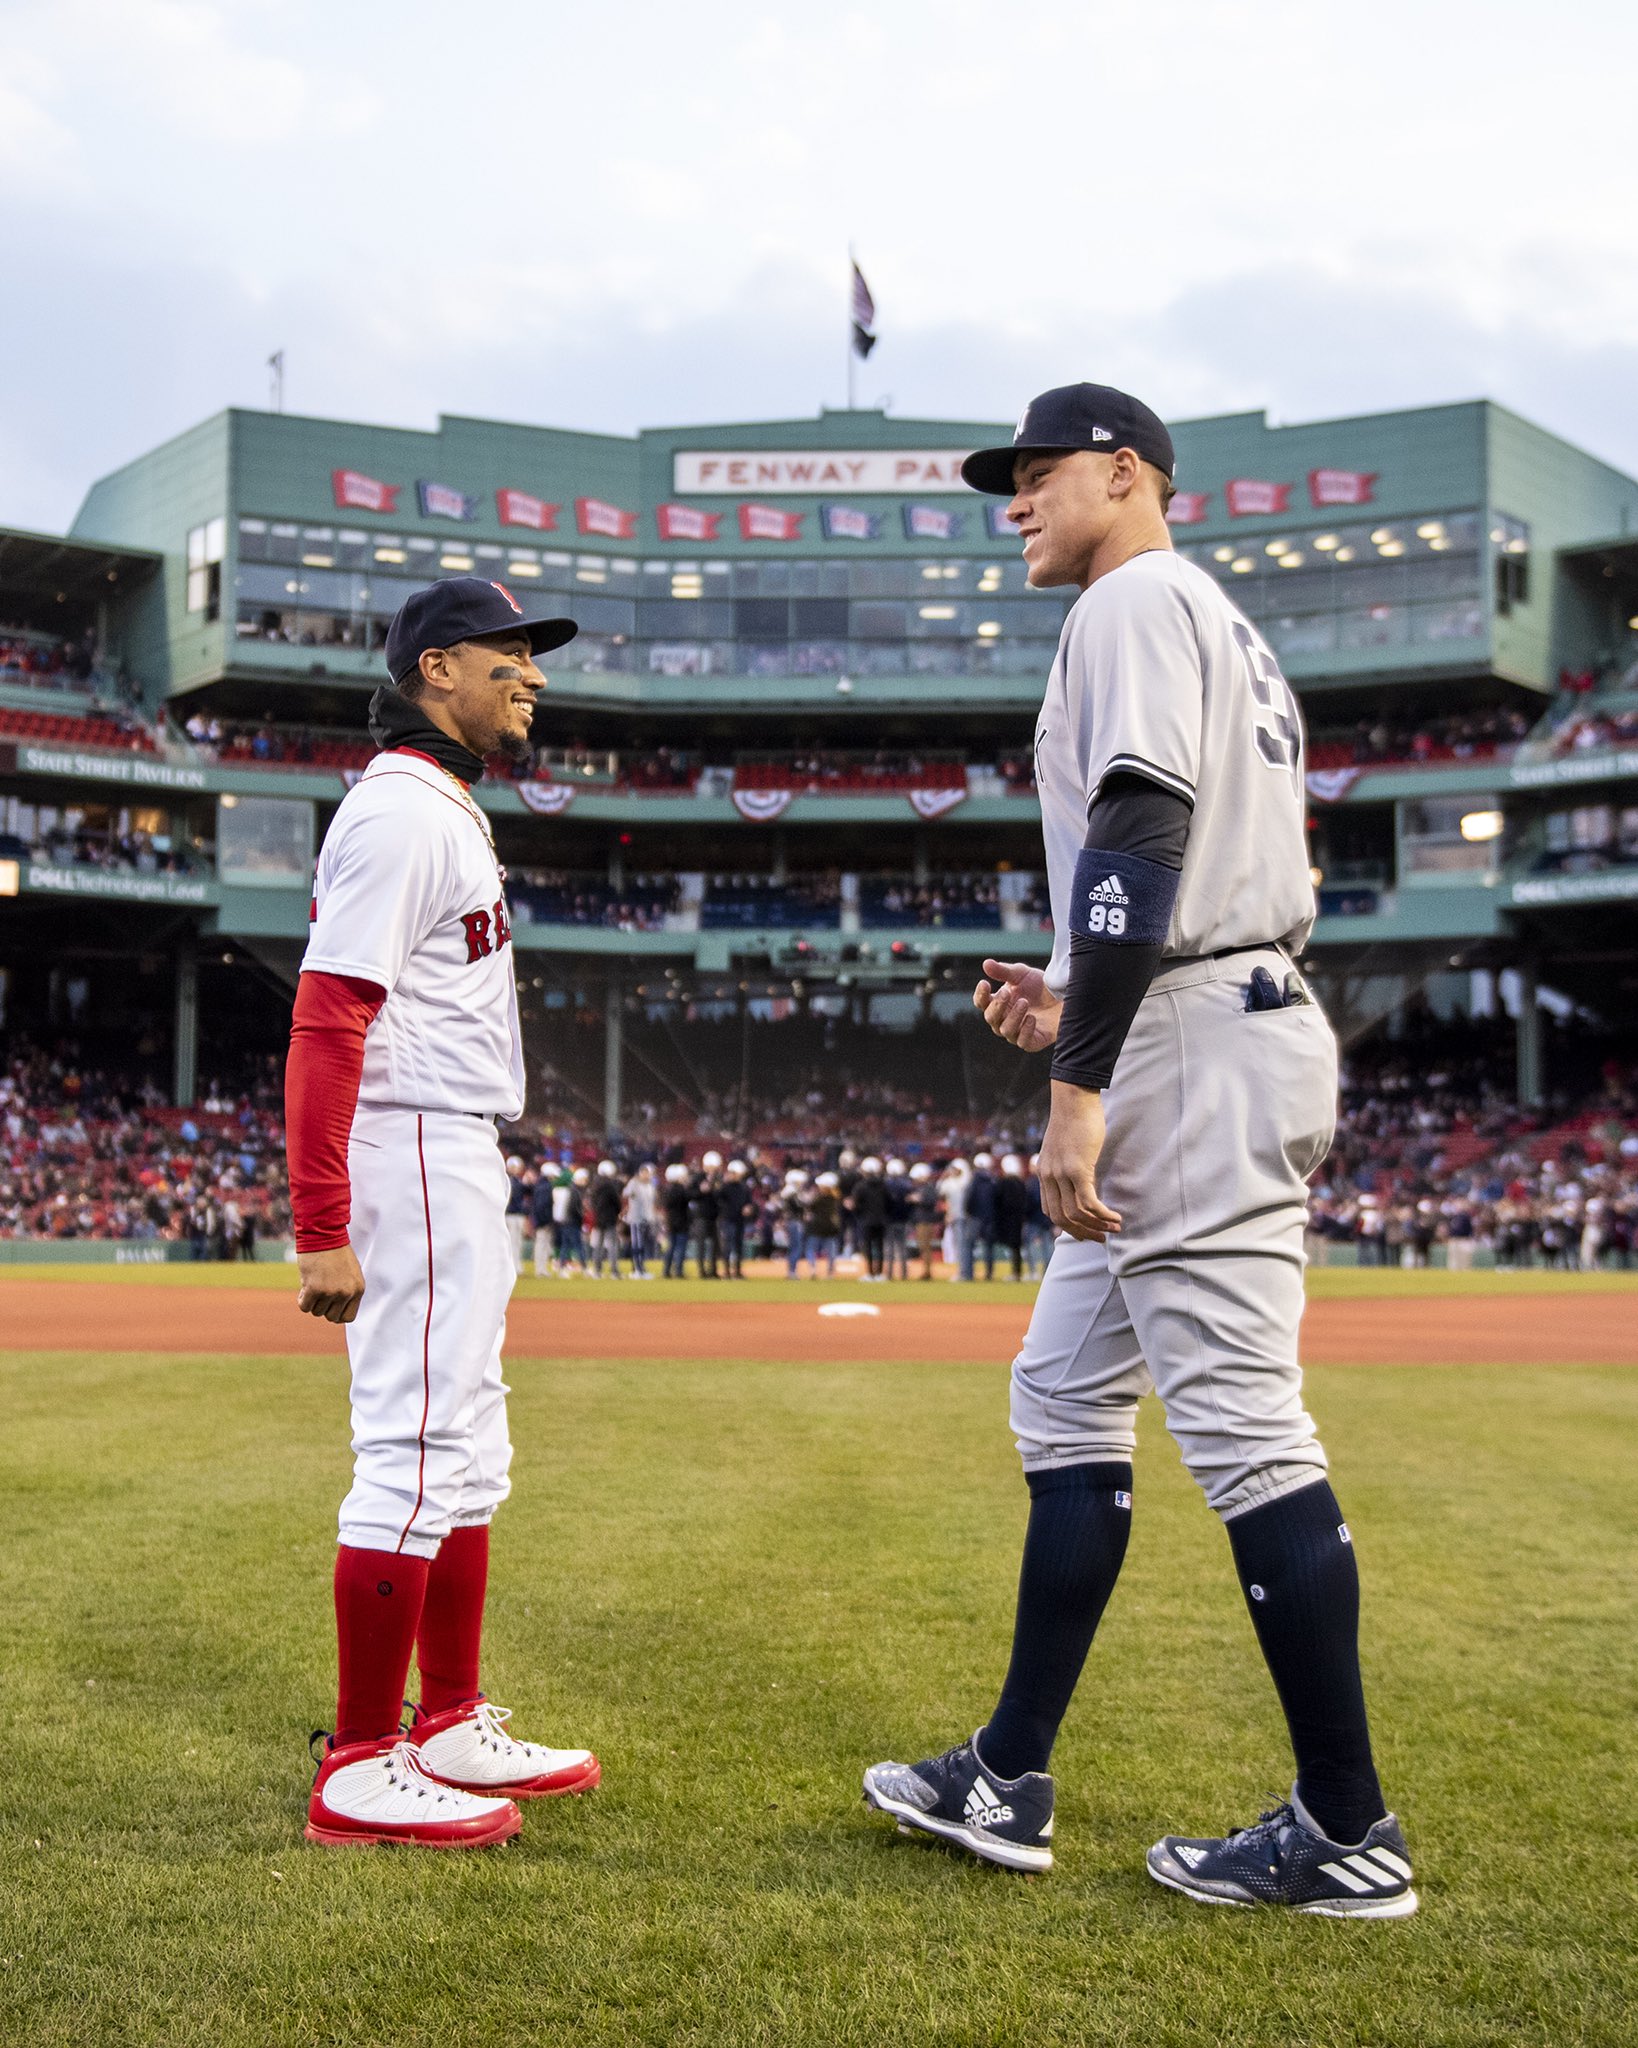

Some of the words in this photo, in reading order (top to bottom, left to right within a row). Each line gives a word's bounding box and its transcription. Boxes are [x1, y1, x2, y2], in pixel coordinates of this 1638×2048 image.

[699, 460, 866, 485] FENWAY
[27, 750, 73, 774] STATE
[75, 754, 131, 780] STREET
[133, 760, 205, 788] PAVILION
[1088, 890, 1129, 905] adidas
[1088, 904, 1126, 936] 99
